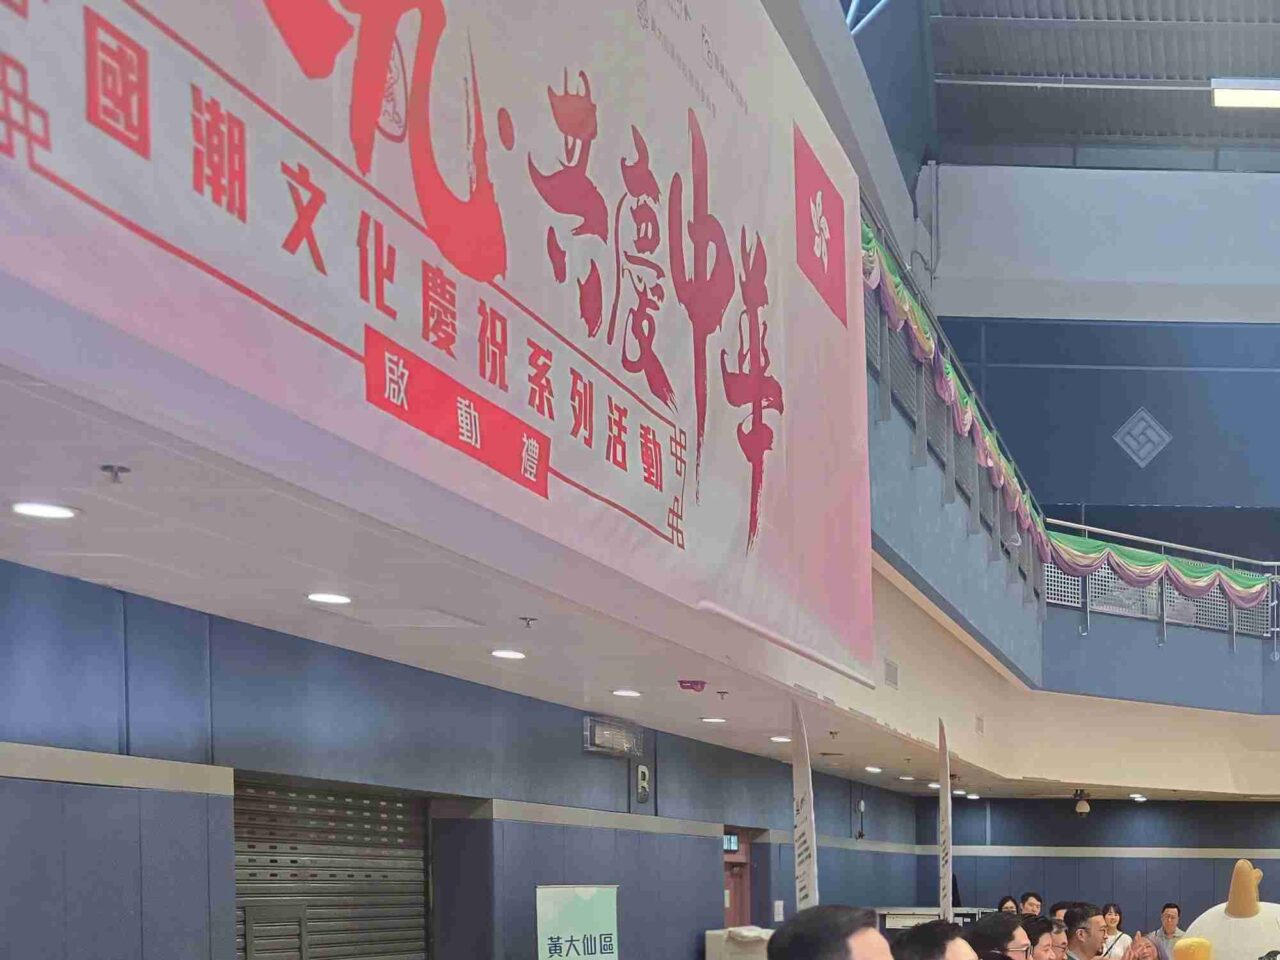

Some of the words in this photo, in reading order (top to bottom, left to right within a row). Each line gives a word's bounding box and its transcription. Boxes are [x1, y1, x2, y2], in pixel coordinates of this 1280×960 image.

[83, 5, 663, 493] 國潮文化慶祝系列活動
[547, 933, 615, 959] 黃大仙區
